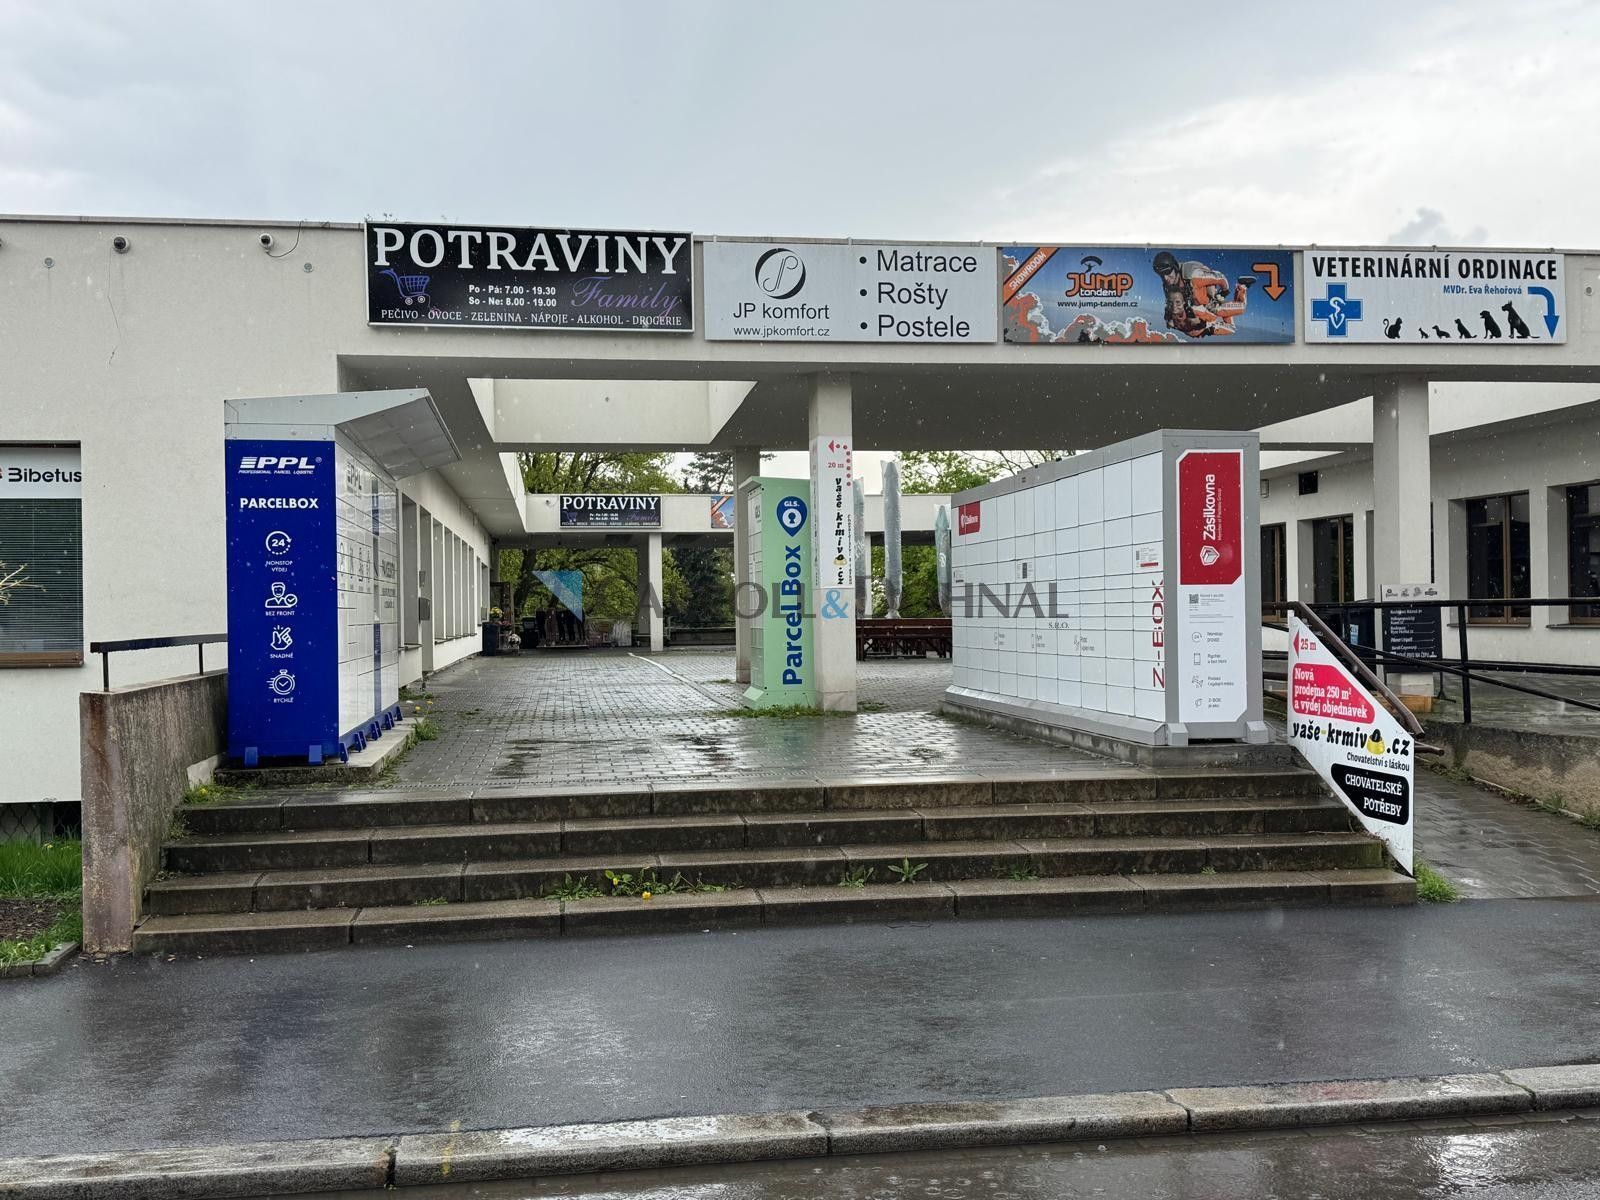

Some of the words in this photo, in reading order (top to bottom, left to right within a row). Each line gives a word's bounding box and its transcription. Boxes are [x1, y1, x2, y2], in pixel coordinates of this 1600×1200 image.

[373, 227, 686, 275] POTRAVINY
[877, 250, 977, 272] Matrace
[1312, 254, 1450, 279] VETERINÁRNÍ
[1458, 258, 1558, 280] ORDINACE
[1009, 252, 1047, 291] SHOWROOM
[468, 284, 480, 294] Po
[488, 284, 502, 294] Pá:
[504, 286, 524, 294] 7.00
[532, 286, 556, 296] 19.30
[571, 276, 680, 318] Family
[877, 282, 948, 310] Rošty
[1080, 288, 1117, 297] tandem
[1443, 285, 1467, 294] MVDr.
[1468, 286, 1482, 294] Eva
[1484, 284, 1522, 295] Řehořová
[468, 296, 480, 305] So
[488, 297, 503, 306] Ne:
[506, 298, 525, 306] 8.00
[532, 298, 557, 307] 19.00
[381, 308, 418, 319] PEČIVO
[428, 310, 462, 320] OVOCE
[470, 312, 522, 322] ZELENINA
[530, 312, 568, 324] NÁPOJE
[576, 314, 624, 324] ALKOHOL
[632, 315, 682, 326] DROGERIE
[733, 302, 756, 319] JP
[762, 302, 830, 320] komfort
[734, 326, 830, 338] www.jpkomfort.cz
[878, 314, 970, 338] Postele
[256, 456, 316, 469] PPL
[8, 467, 82, 482] Bibetus
[240, 498, 319, 509] PARCELBOX
[562, 496, 658, 510] POTRAVINY
[1202, 474, 1216, 540] Zásilkovna
[271, 538, 285, 547] 24
[1152, 580, 1164, 688] Z-BOX
[1300, 639, 1309, 650] 25
[1310, 642, 1316, 650] m
[1294, 668, 1314, 680] Nová
[1294, 683, 1324, 700] prodejna
[1327, 686, 1339, 698] 250
[1294, 701, 1299, 709] a
[1300, 698, 1320, 714] výdej
[1322, 700, 1367, 718] objednávek
[1347, 752, 1383, 766] Chovatelství
[1389, 760, 1410, 771] láskou
[1345, 774, 1402, 796] CHOVATELSKÉ
[1363, 797, 1402, 816] POTŘEBY
